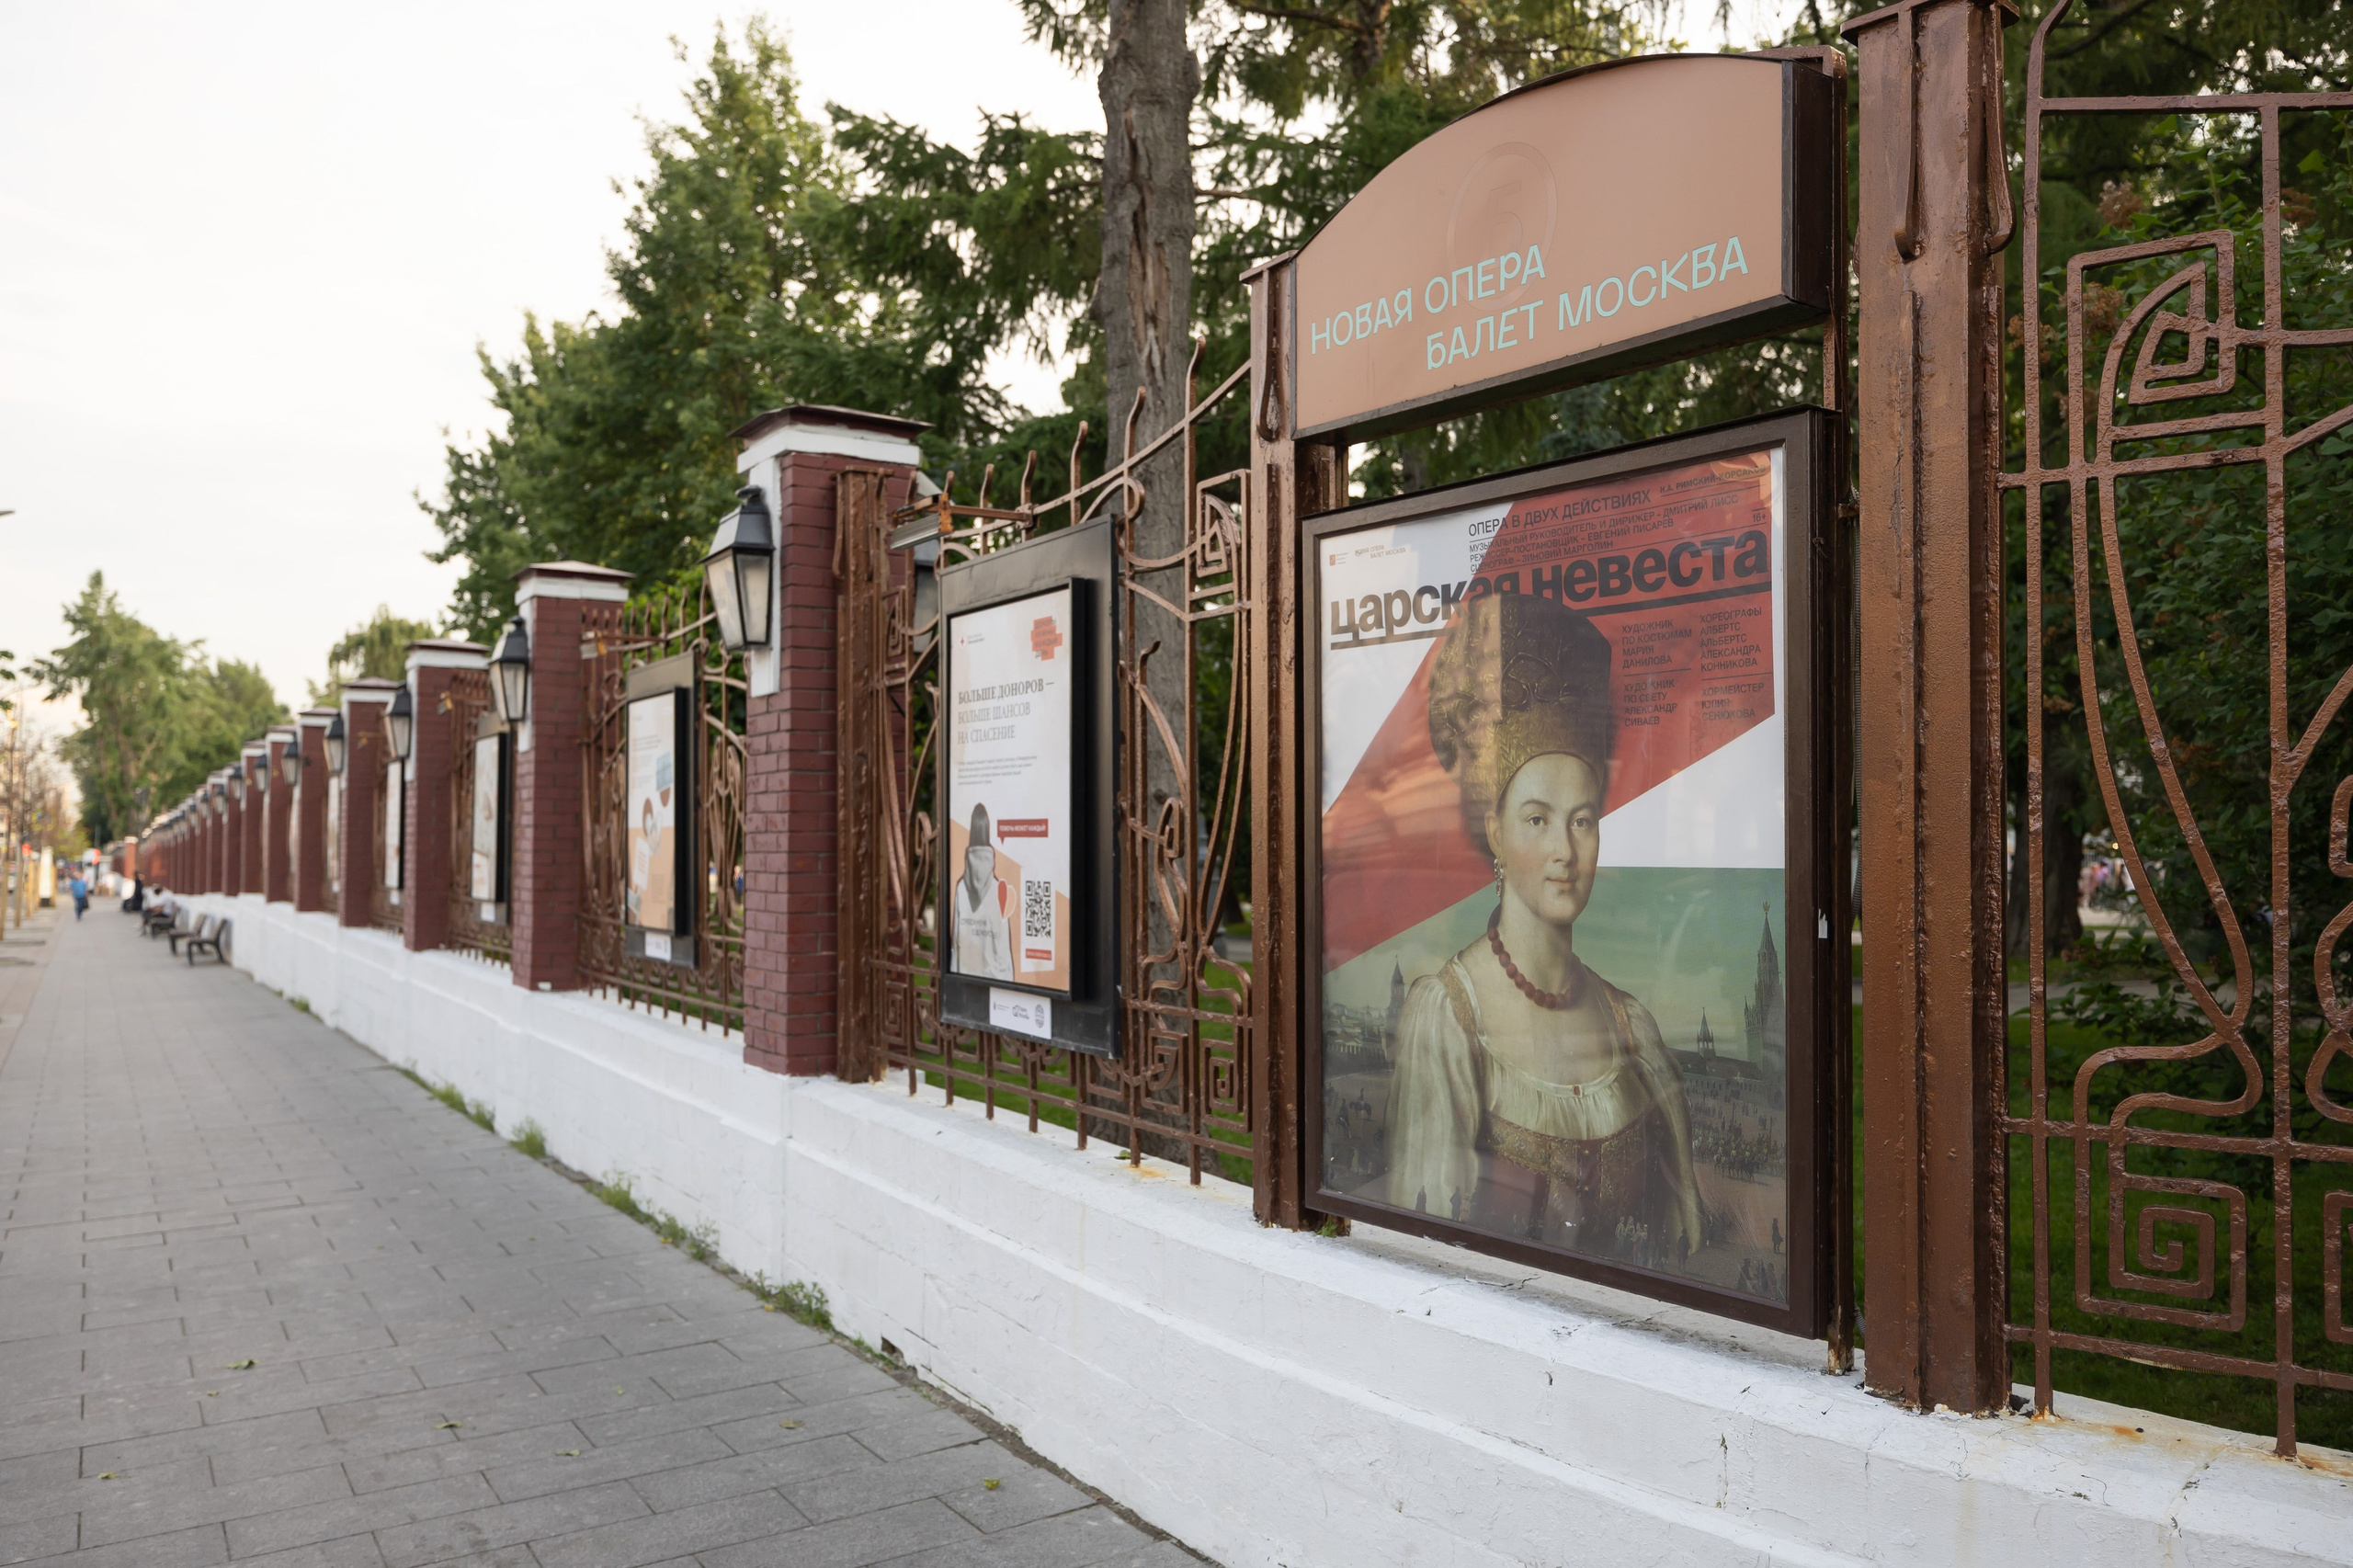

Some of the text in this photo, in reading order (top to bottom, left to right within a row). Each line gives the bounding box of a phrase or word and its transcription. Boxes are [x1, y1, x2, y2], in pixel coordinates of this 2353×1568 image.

[1312, 244, 1546, 355] НОВАЯ ОПЕРА
[1427, 236, 1748, 370] БАЛЕТ МОСКВА
[1676, 465, 1767, 490] РИМСКИЙ-КОРСАКОВ
[1469, 489, 1651, 537] ОПЕРА В ДВУХ ДЕЙСТВИЯХ
[1752, 513, 1767, 523] 16+
[1470, 533, 1528, 553] МУЗЫКАЛЬНЫЙ
[1529, 519, 1597, 540] РУКОВОДИТЕЛЬ
[1599, 517, 1607, 528] И
[1608, 511, 1654, 529] ДИРИЖЕР
[1663, 499, 1708, 518] ДМИТРИЙ
[1711, 494, 1738, 509] ЛИСС
[1470, 534, 1579, 563] РЕЖИССЕР-ПОСТАНОВЩИК
[1587, 527, 1631, 540] ЕВГЕНИЙ
[1632, 517, 1674, 534] ПИСАРЕВ
[1471, 556, 1514, 574] СЦЕНОГРАФ
[1522, 547, 1563, 562] ЗИНОВИЙ
[1563, 540, 1614, 556] МАРГОЛИН
[1531, 529, 1768, 605] невеста
[1700, 607, 1762, 623] ХОРЕОГРАФЫ
[1621, 619, 1674, 634] ХУДОЖНИК
[1700, 622, 1741, 635] АЛБЕРТС
[1621, 629, 1692, 646] ПО КОСТЮМАМ
[1700, 633, 1747, 648] АЛЬБЕРТС
[1622, 645, 1654, 657] МАРИЯ
[1701, 644, 1761, 660] АЛЕКСАНДРА
[1622, 654, 1673, 670] ДАНИЛОВА
[1701, 657, 1757, 672] КОННИКОВА
[958, 687, 996, 705] БОЛЬШЕ
[998, 678, 1044, 700] ДОНОРОВ
[1624, 692, 1667, 703] ПО СВЕТУ
[1701, 682, 1765, 697] ХОРМЕЙСТЕР
[958, 701, 1030, 724] БОЛЬШЕ ШАНСОВ
[1624, 702, 1677, 715] АЛЕКСАНДР
[1624, 716, 1660, 727] СИВАЕВ
[958, 724, 1016, 744] НА СПАСЕНИЕ
